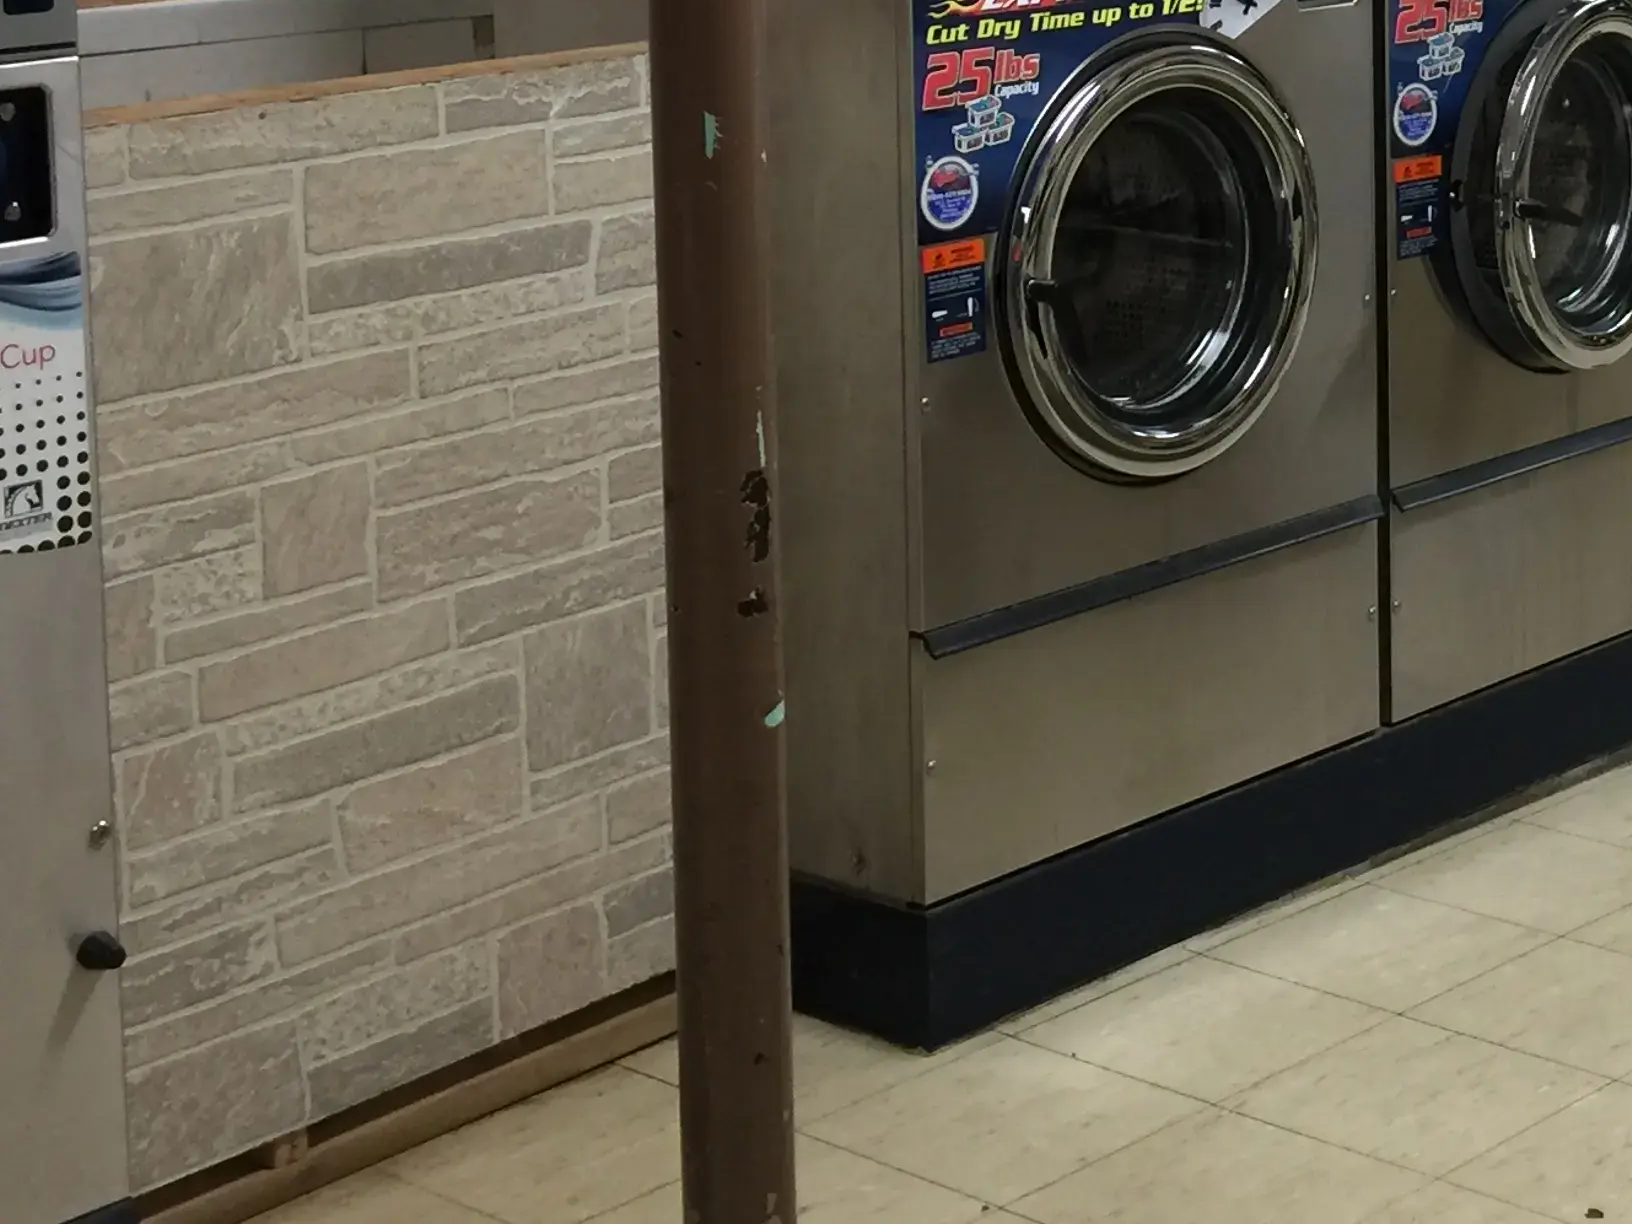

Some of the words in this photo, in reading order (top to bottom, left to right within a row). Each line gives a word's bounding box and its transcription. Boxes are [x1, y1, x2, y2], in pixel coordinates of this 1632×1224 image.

[925, 22, 970, 46] Cut
[976, 19, 1021, 41] Dry
[1029, 10, 1086, 34] Time
[1092, 7, 1124, 28] up
[1129, 2, 1155, 21] to
[993, 80, 1041, 100] Capacity
[0, 341, 57, 370] Cup
